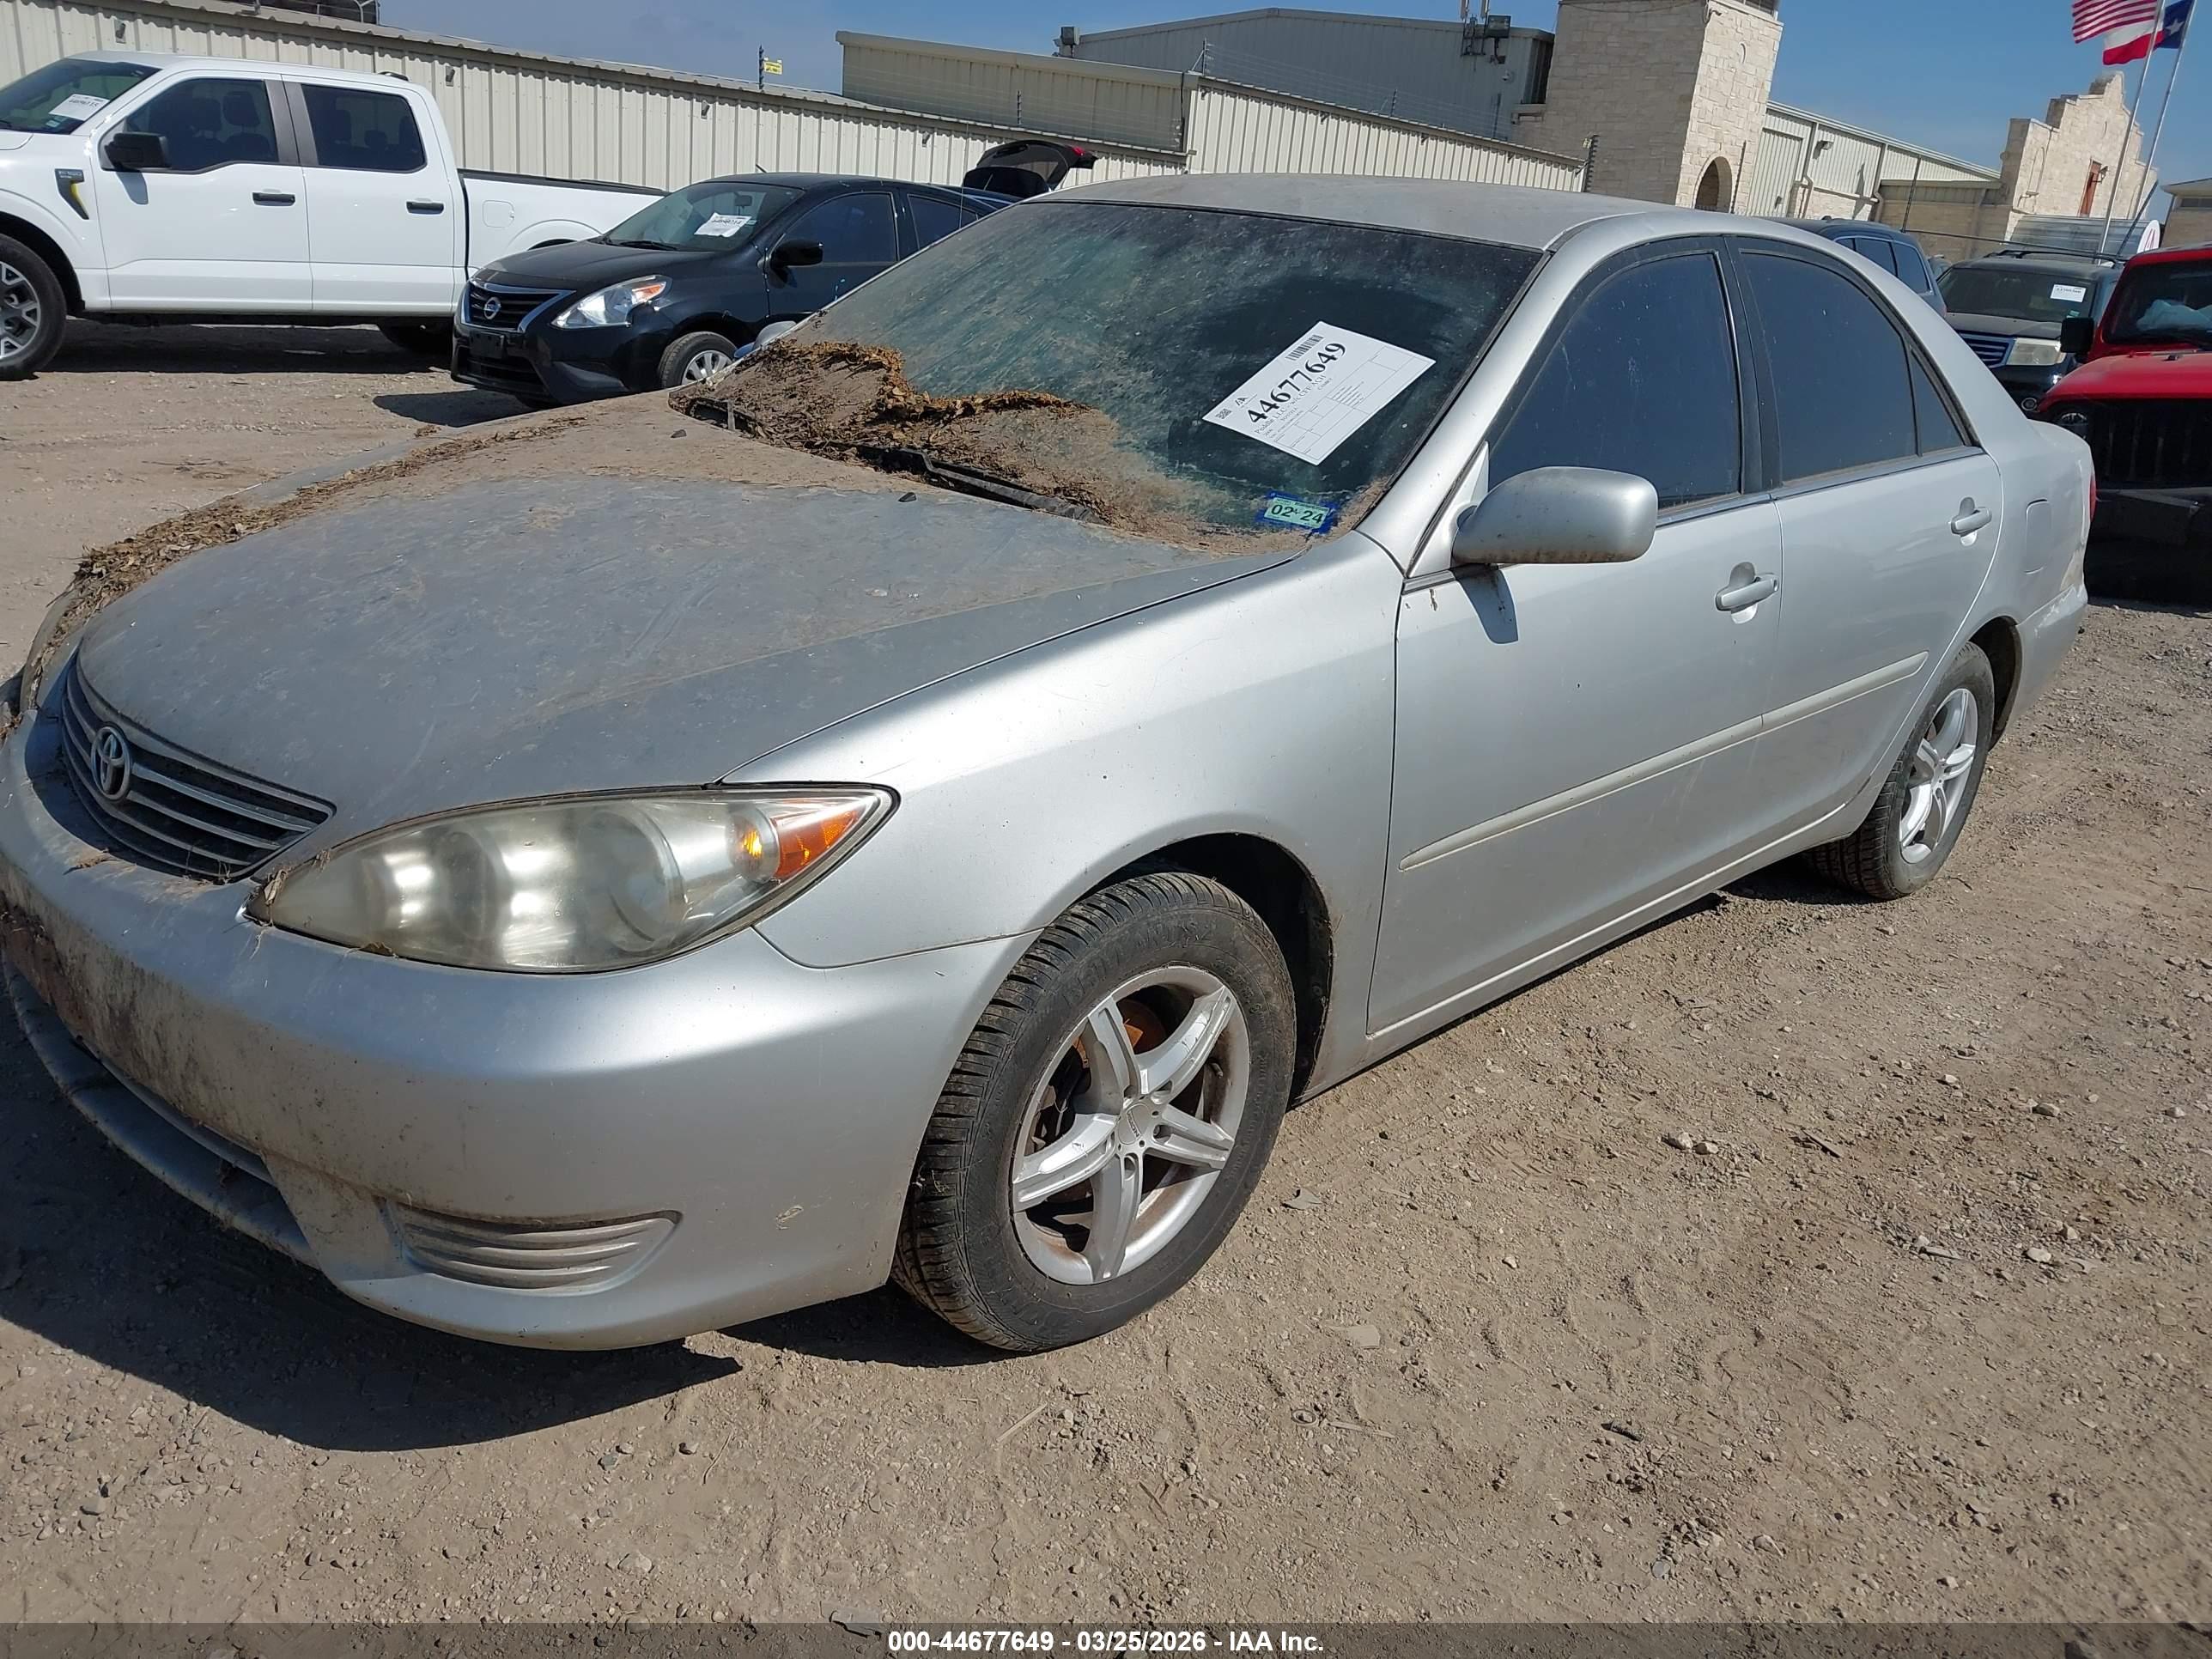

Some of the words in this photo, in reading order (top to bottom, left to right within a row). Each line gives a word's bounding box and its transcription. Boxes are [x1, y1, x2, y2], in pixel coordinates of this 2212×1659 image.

[1248, 343, 1346, 423] 44677649
[1271, 504, 1293, 517] 02
[1300, 510, 1323, 524] 24
